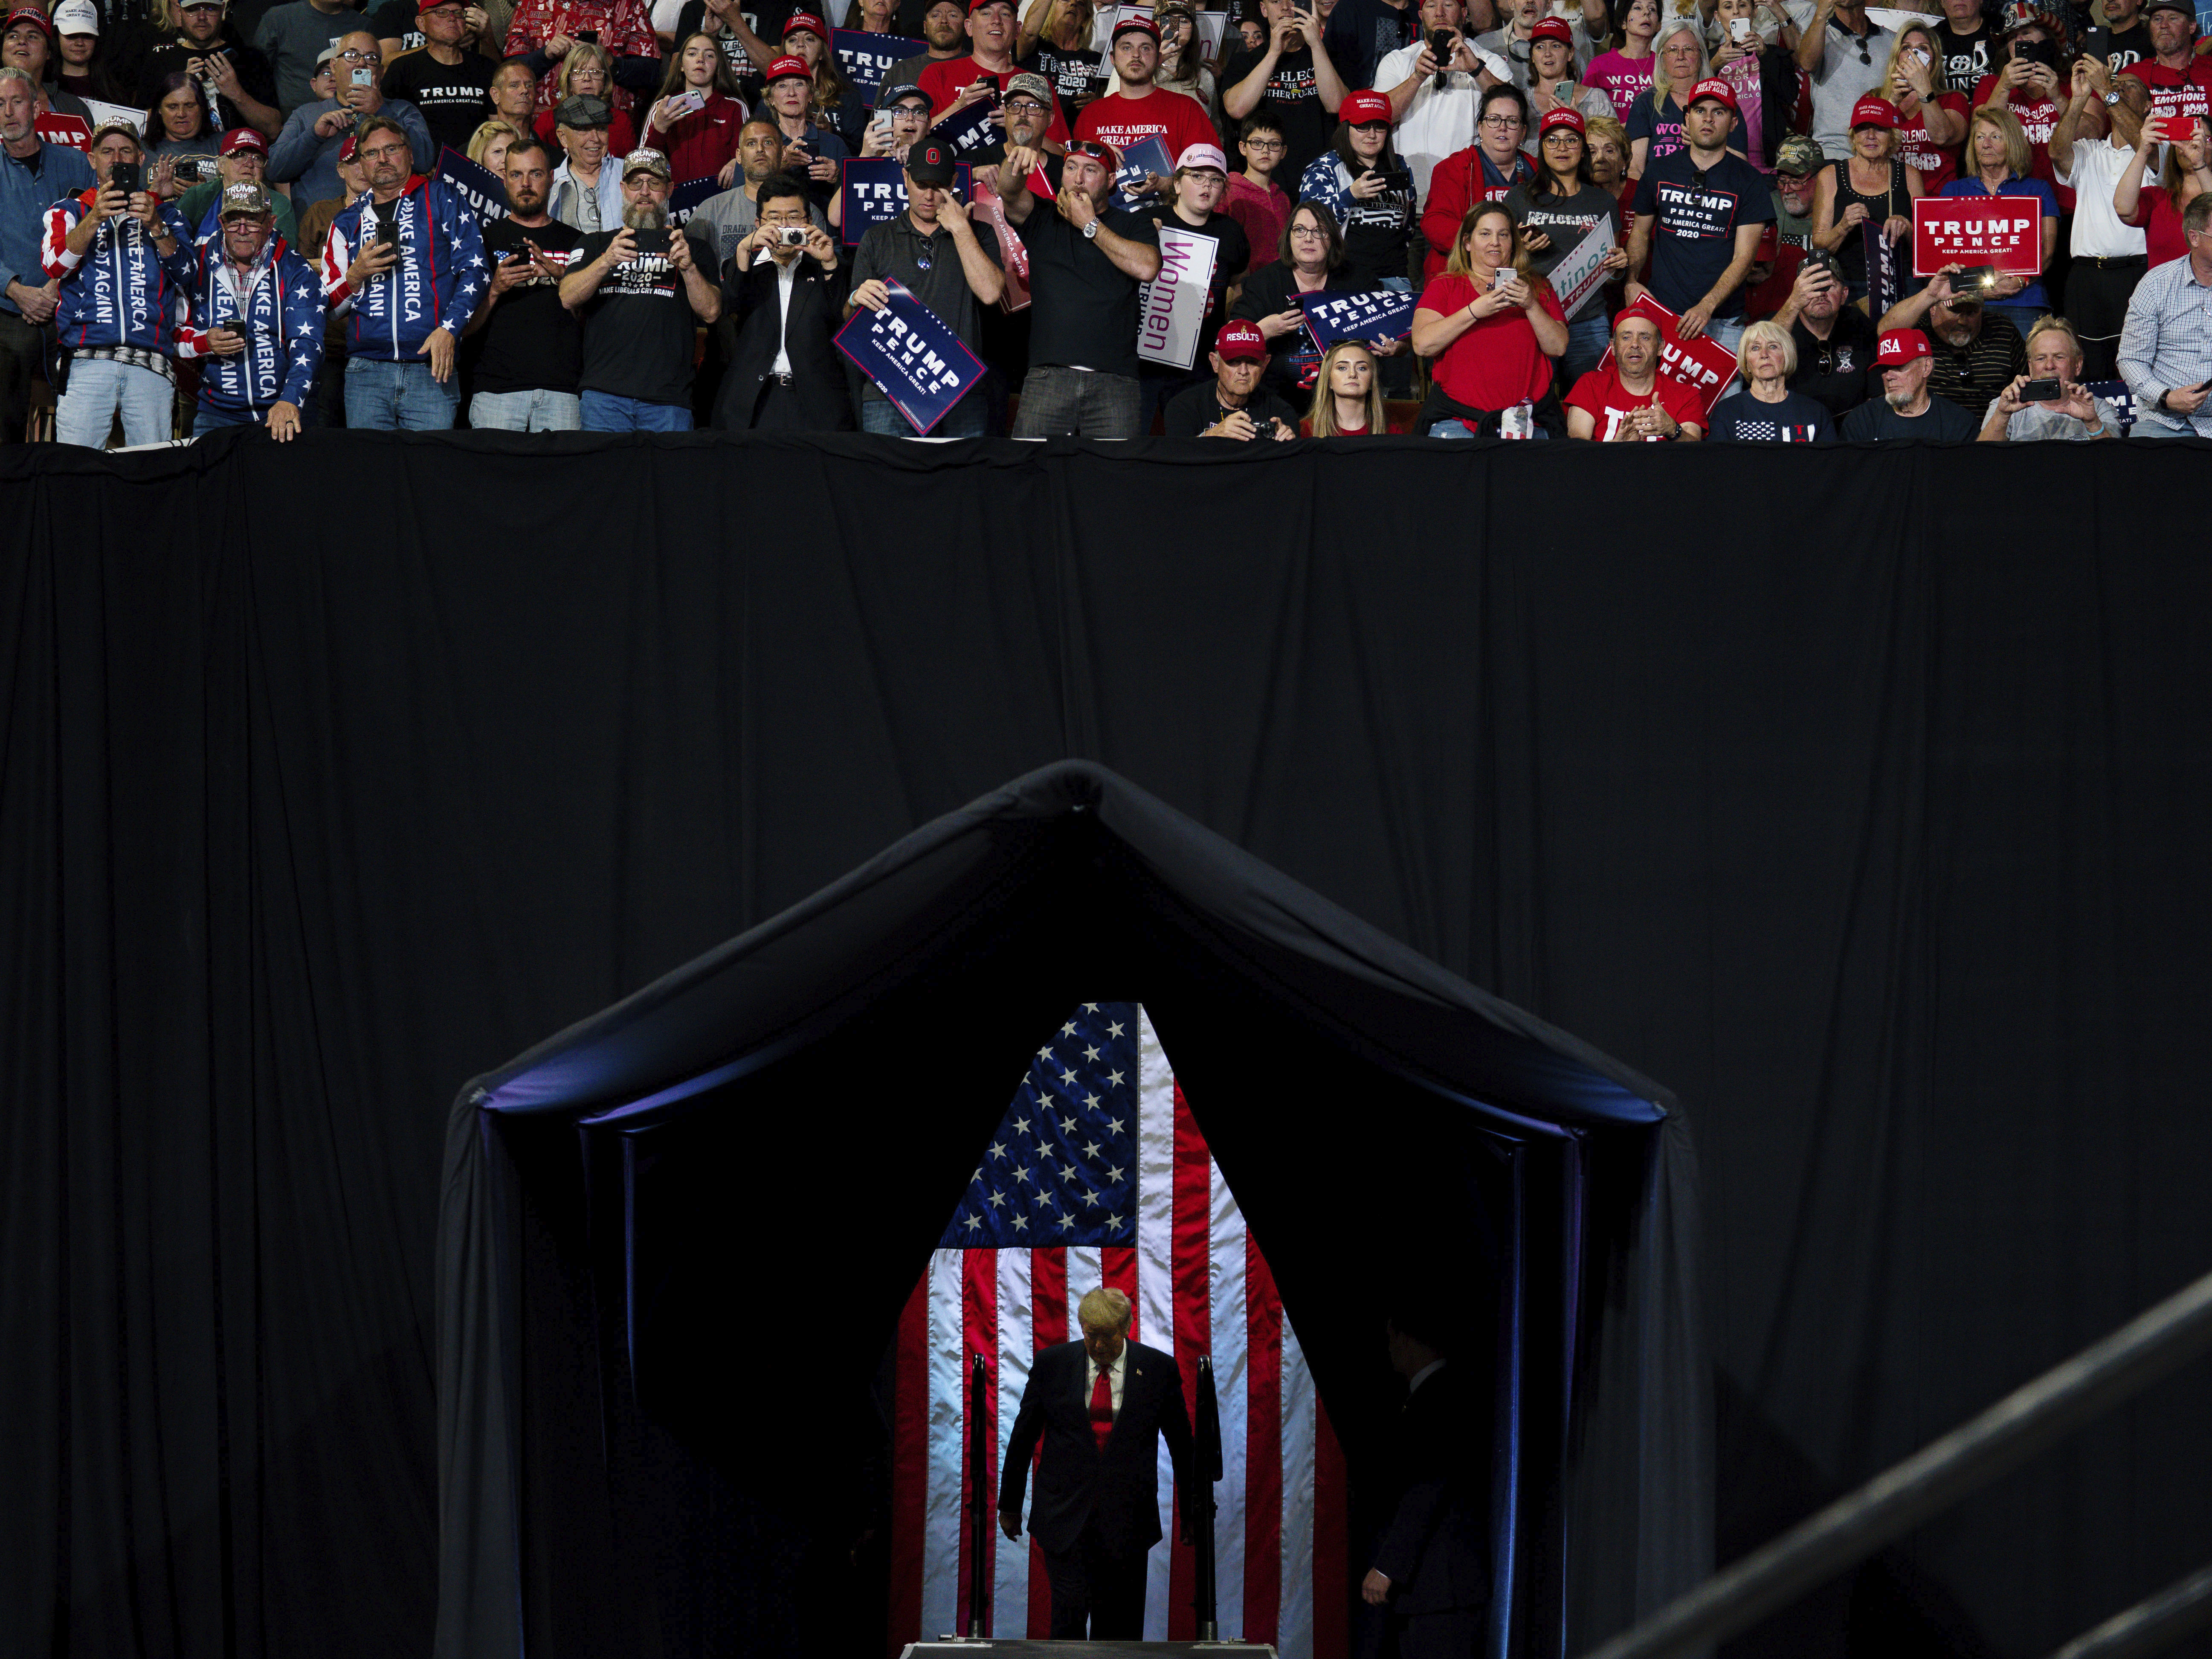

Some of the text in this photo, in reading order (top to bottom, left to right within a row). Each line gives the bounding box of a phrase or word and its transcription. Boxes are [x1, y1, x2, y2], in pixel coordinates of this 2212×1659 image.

[772, 60, 784, 68] MAKE
[1058, 75, 1087, 87] 2020
[1606, 75, 1652, 85] WOM
[1727, 73, 1749, 81] FOR
[1055, 85, 1075, 96] Your
[1695, 86, 1711, 94] GREAT
[1711, 86, 1728, 97] AGAIN
[1696, 81, 1708, 90] MAKE
[1708, 80, 1728, 90] TRAPPERS
[420, 87, 484, 98] TRUMP
[2154, 93, 2206, 104] EMOTIONS
[2183, 103, 2209, 117] 2020
[99, 116, 131, 127] TRUMP
[1561, 113, 1578, 122] AMERICA
[1096, 125, 1168, 135] MAKE AMERICA
[1100, 136, 1131, 145] GREAT
[628, 149, 660, 161] TRUMP
[926, 148, 940, 165] O
[226, 184, 258, 196] TRUMP
[853, 183, 909, 199] TRU
[1661, 189, 1732, 211] TRUMP
[1670, 208, 1713, 220] PENCE
[722, 224, 746, 234] DRAIN
[1672, 219, 1699, 229] AMERICA
[1702, 223, 1726, 232] GREAT!
[1924, 219, 2030, 235] TRUMP
[991, 206, 1025, 275] KEEP AMERICA GREAT!
[1676, 229, 1699, 238] 2020
[1934, 235, 2020, 246] PENCE
[1557, 242, 1608, 299] tinos
[1879, 234, 1889, 315] RUMP
[400, 245, 421, 322] AMERICA
[94, 268, 113, 324] AGAIN!
[129, 259, 147, 332] AMERICA
[369, 273, 385, 317] GAIN!
[599, 287, 614, 295] MAKE
[654, 288, 674, 298] AGAIN!
[1143, 242, 1194, 351] Women
[1312, 290, 1406, 319] TRUM
[1330, 294, 1412, 328] PENCE
[1342, 304, 1409, 333] KEEP AMERICA GREAT!
[1226, 333, 1259, 342] RESULTS
[875, 307, 960, 388] TRUMP
[1879, 339, 1902, 356] USA
[253, 319, 277, 399] AMERICA
[871, 323, 941, 394] PENCE
[1663, 342, 1719, 386] UMP
[871, 339, 886, 353] KEEP
[885, 352, 909, 377] AMERICA
[908, 375, 927, 395] GREAT!
[876, 380, 888, 394] 2020
